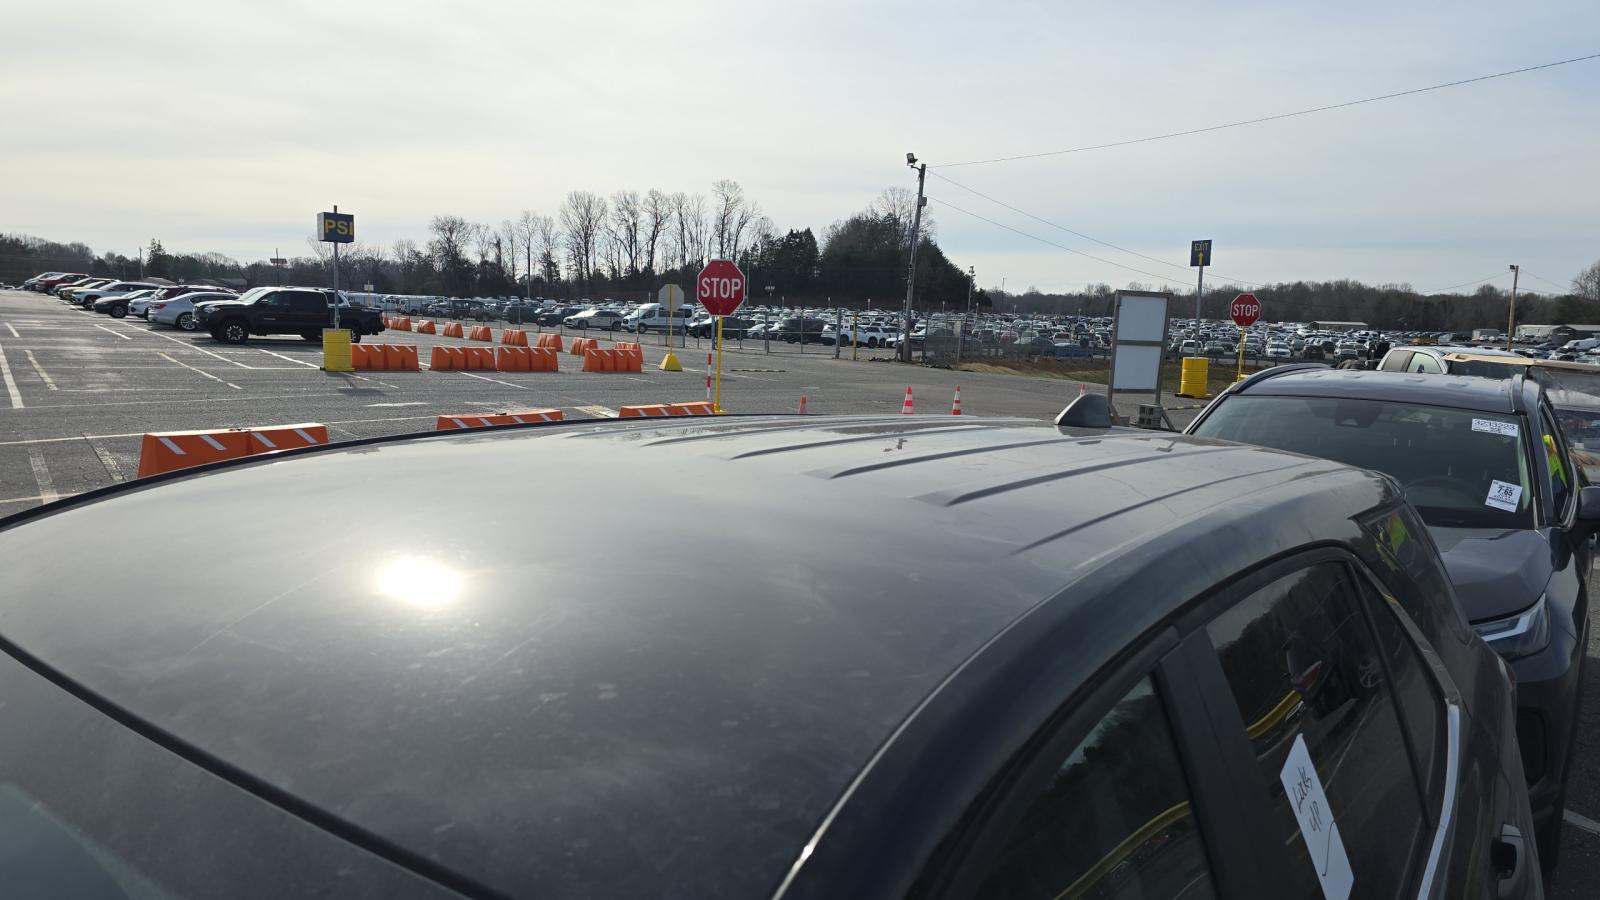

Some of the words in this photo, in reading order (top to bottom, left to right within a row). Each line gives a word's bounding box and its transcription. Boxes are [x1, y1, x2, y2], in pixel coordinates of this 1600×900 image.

[325, 219, 354, 236] PSI
[700, 277, 742, 299] STOP
[1233, 304, 1259, 317] STOP
